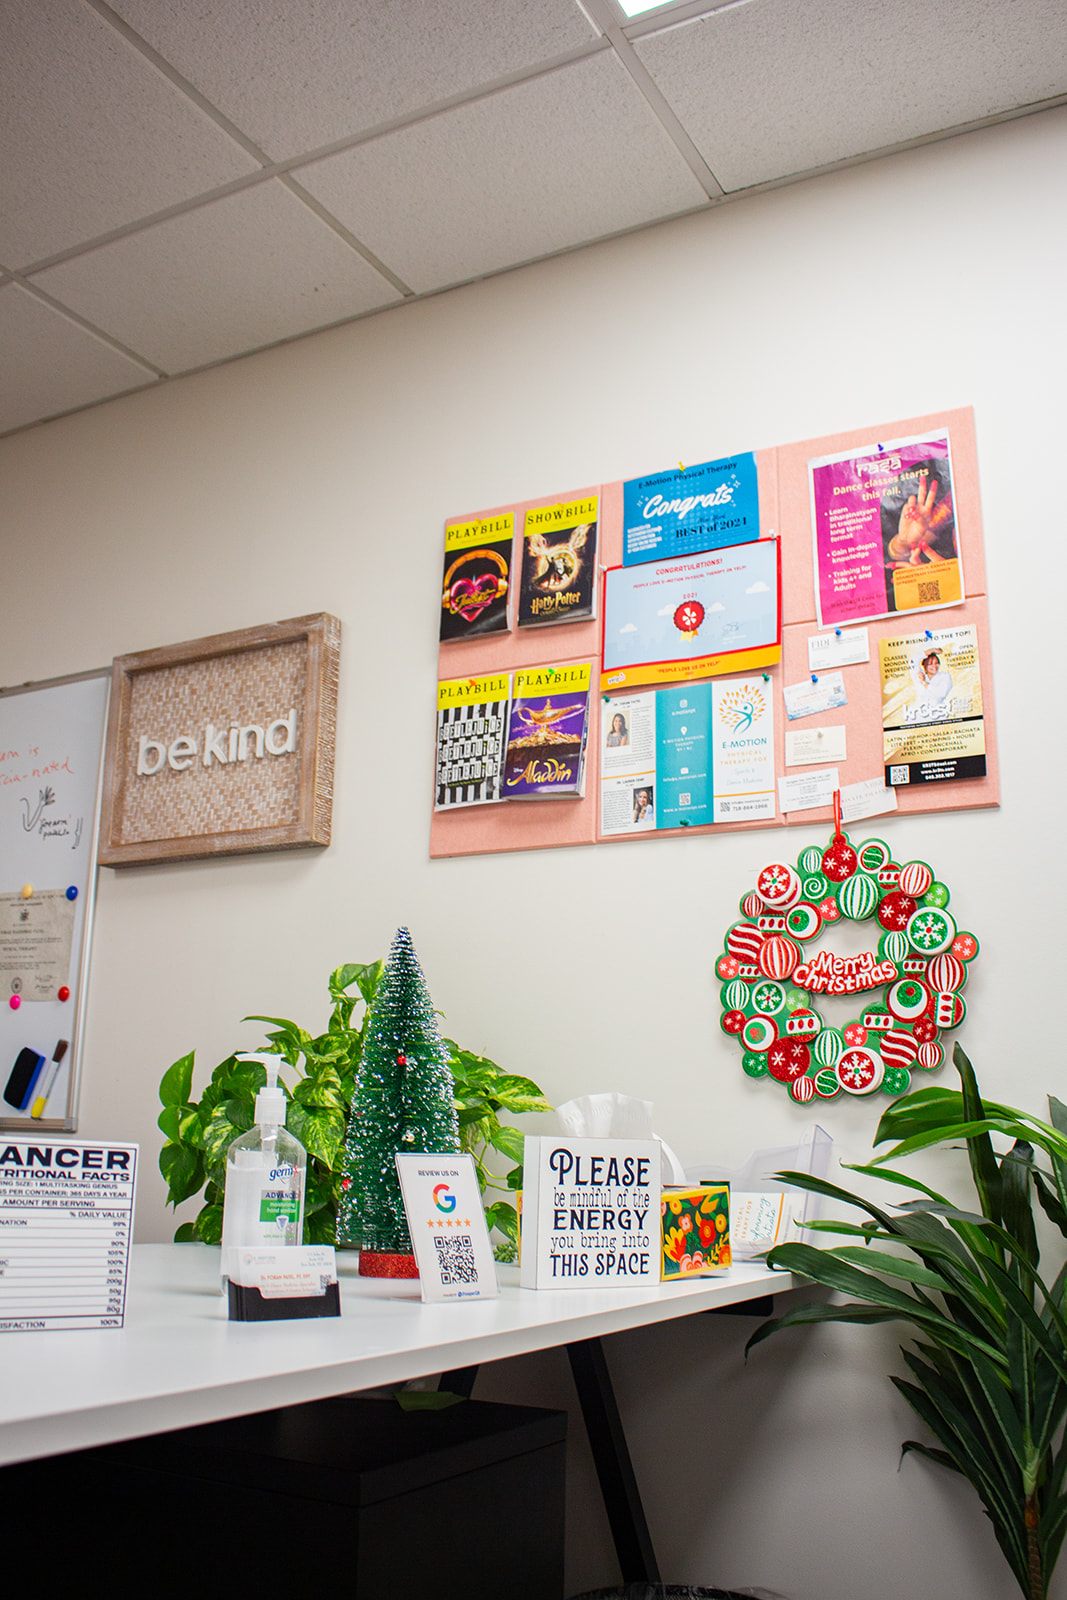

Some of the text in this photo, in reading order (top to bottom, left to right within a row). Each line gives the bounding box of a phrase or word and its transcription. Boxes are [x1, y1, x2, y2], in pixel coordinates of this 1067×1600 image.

[674, 470, 704, 482] Physical
[707, 462, 738, 474] Therapy
[834, 468, 929, 496] Dance classes starts
[643, 483, 734, 520] Congrats
[862, 491, 880, 502] this
[528, 503, 595, 524] SHOWBILL
[448, 520, 510, 540] PLAYBILL
[676, 526, 704, 538] BEST
[832, 548, 847, 557] Gain
[832, 552, 869, 564] knowledge
[833, 566, 861, 578] Training
[834, 576, 848, 585] kids
[834, 584, 856, 592] Adults
[518, 670, 586, 686] PLAYBILL
[440, 680, 506, 698] PLAYBILL
[137, 708, 297, 775] be kind
[506, 758, 572, 786] Aladdin
[811, 952, 874, 976] Merry
[793, 961, 896, 992] Christmas
[81, 1172, 130, 1181] FACTS
[554, 1187, 650, 1207] be mindful of the
[554, 1209, 649, 1230] ENERGY
[551, 1232, 650, 1254] you bring into
[550, 1253, 649, 1276] THIS SPACE
